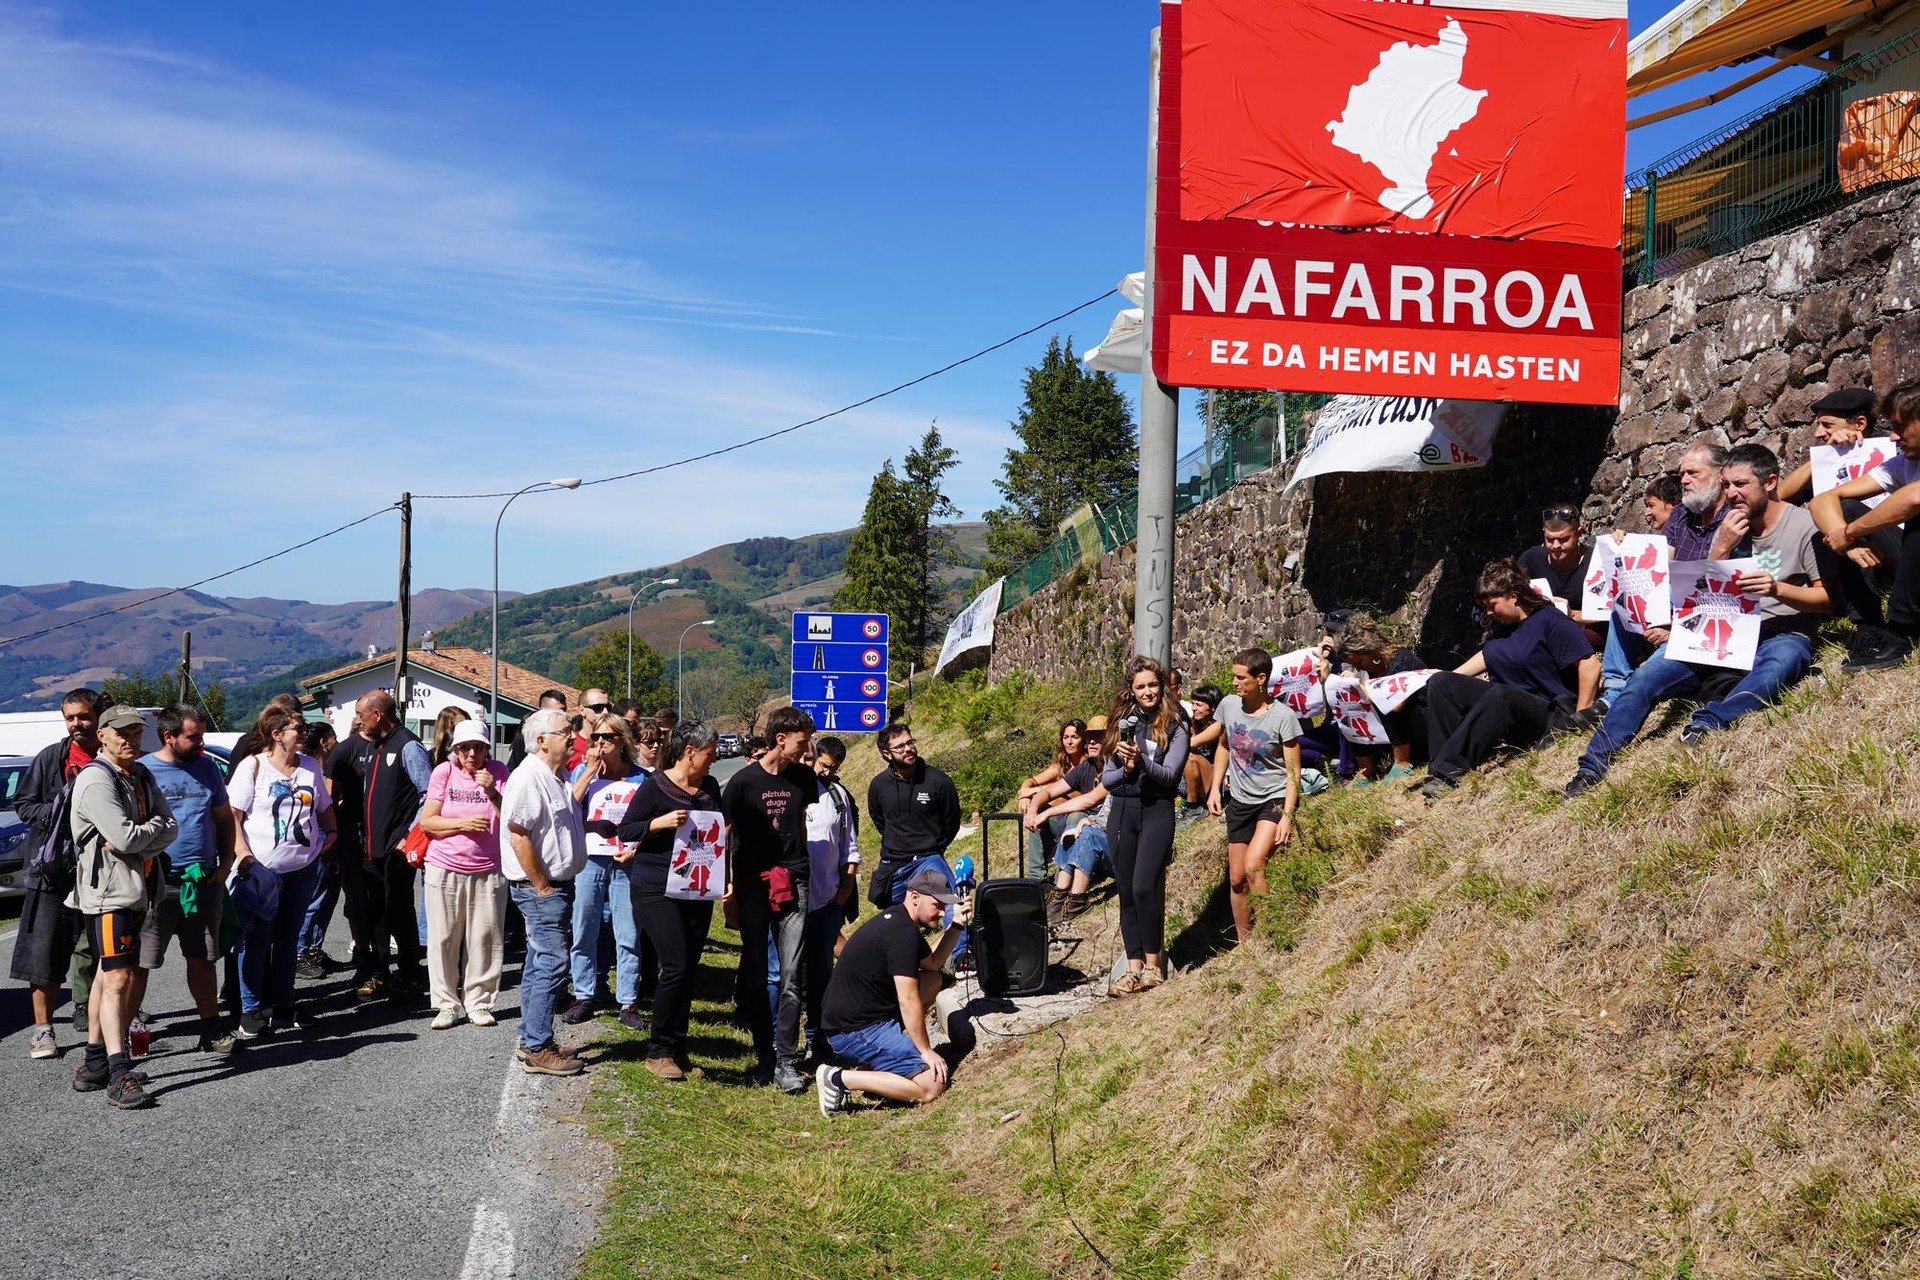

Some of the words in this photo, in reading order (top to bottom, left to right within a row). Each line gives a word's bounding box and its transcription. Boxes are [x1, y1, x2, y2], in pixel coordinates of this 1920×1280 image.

[1181, 253, 1595, 331] NAFARROA
[1209, 339, 1249, 366] EZ
[1262, 342, 1306, 369] DA
[1318, 346, 1437, 377] HEMEN
[1451, 352, 1581, 382] HASTEN
[867, 625, 878, 633] 50
[762, 791, 791, 799] piztuko
